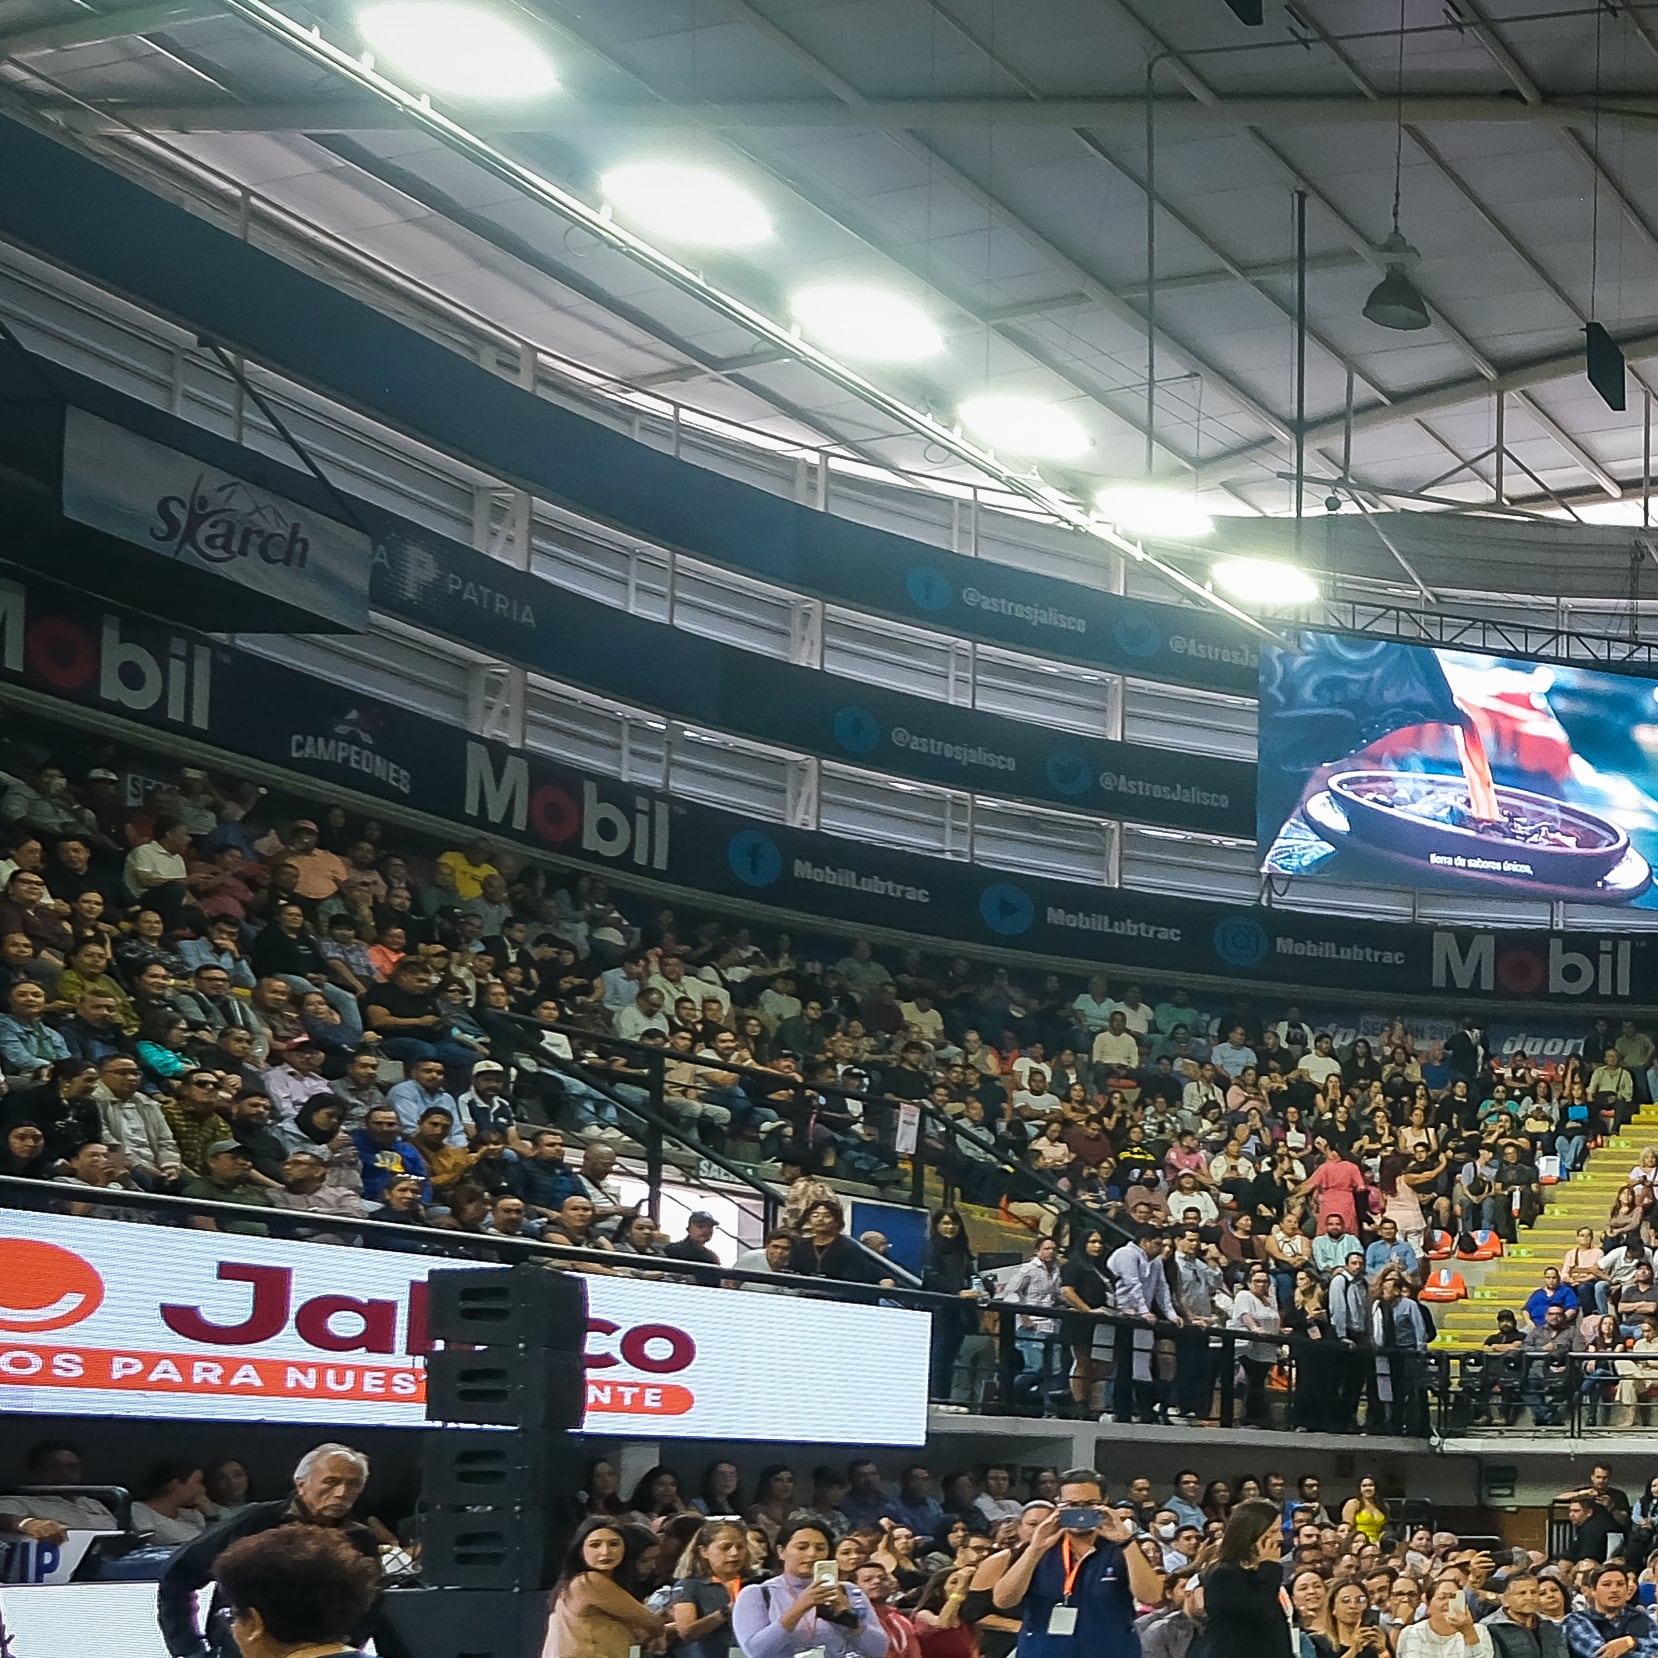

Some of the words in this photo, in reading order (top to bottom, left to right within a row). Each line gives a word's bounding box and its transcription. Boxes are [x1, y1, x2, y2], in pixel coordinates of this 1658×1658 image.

[448, 573, 537, 628] PATRIA
[962, 587, 1087, 633] @astrosjalisco
[290, 734, 411, 794] CAMPEONES
[891, 727, 1016, 771] @astrosjalisco
[464, 741, 668, 870] Mobil
[1099, 771, 1229, 809] @AstrosJalisco
[793, 858, 931, 903] MobilLubtrac
[1047, 906, 1182, 942] MobilLubtrac
[1276, 936, 1405, 964] MobilLubtrac
[1432, 932, 1631, 996] Mobil
[110, 1355, 263, 1388] PARA
